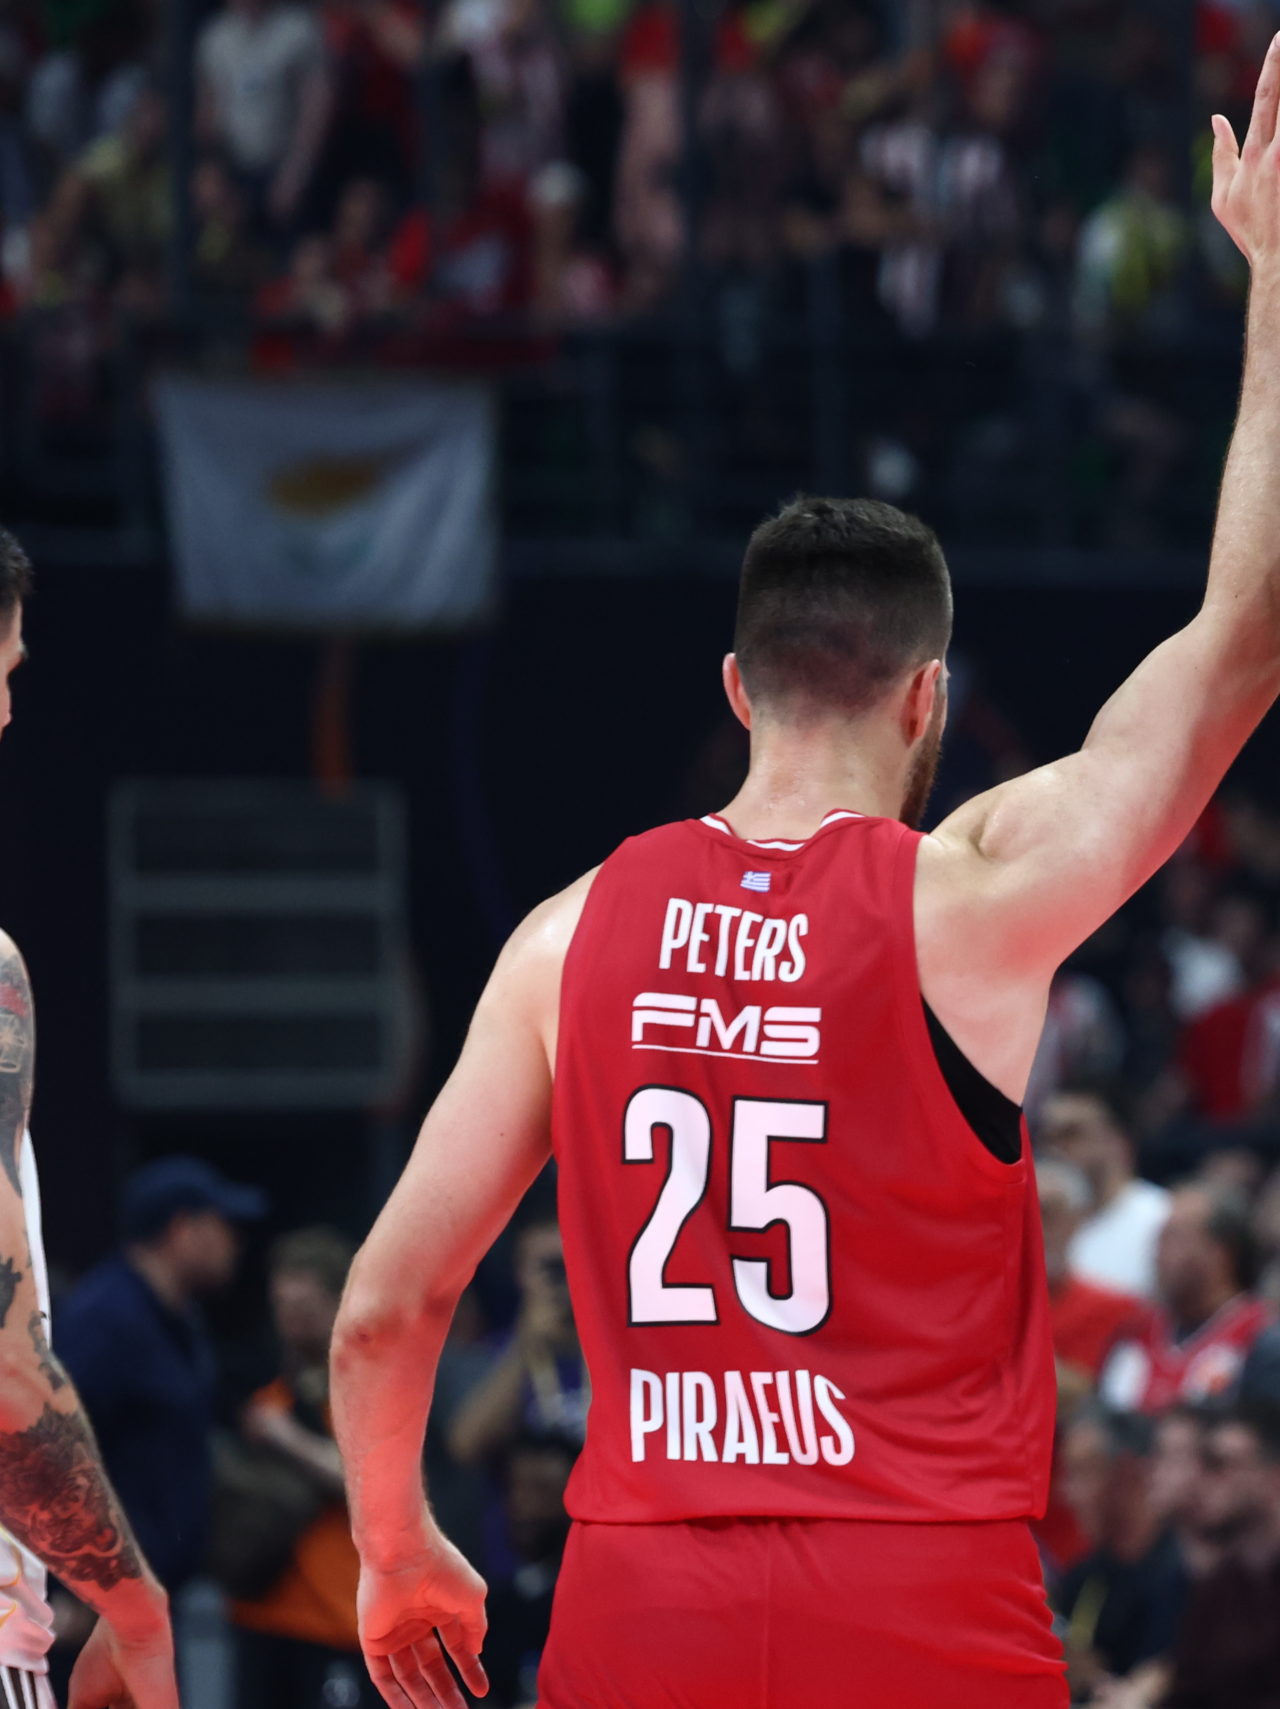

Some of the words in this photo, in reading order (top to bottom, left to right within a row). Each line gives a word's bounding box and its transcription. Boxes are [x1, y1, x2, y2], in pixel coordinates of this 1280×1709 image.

[659, 897, 809, 983] PETERS
[631, 992, 822, 1058] FMS
[621, 1084, 832, 1338] 25
[630, 1368, 855, 1466] PIRAEUS
